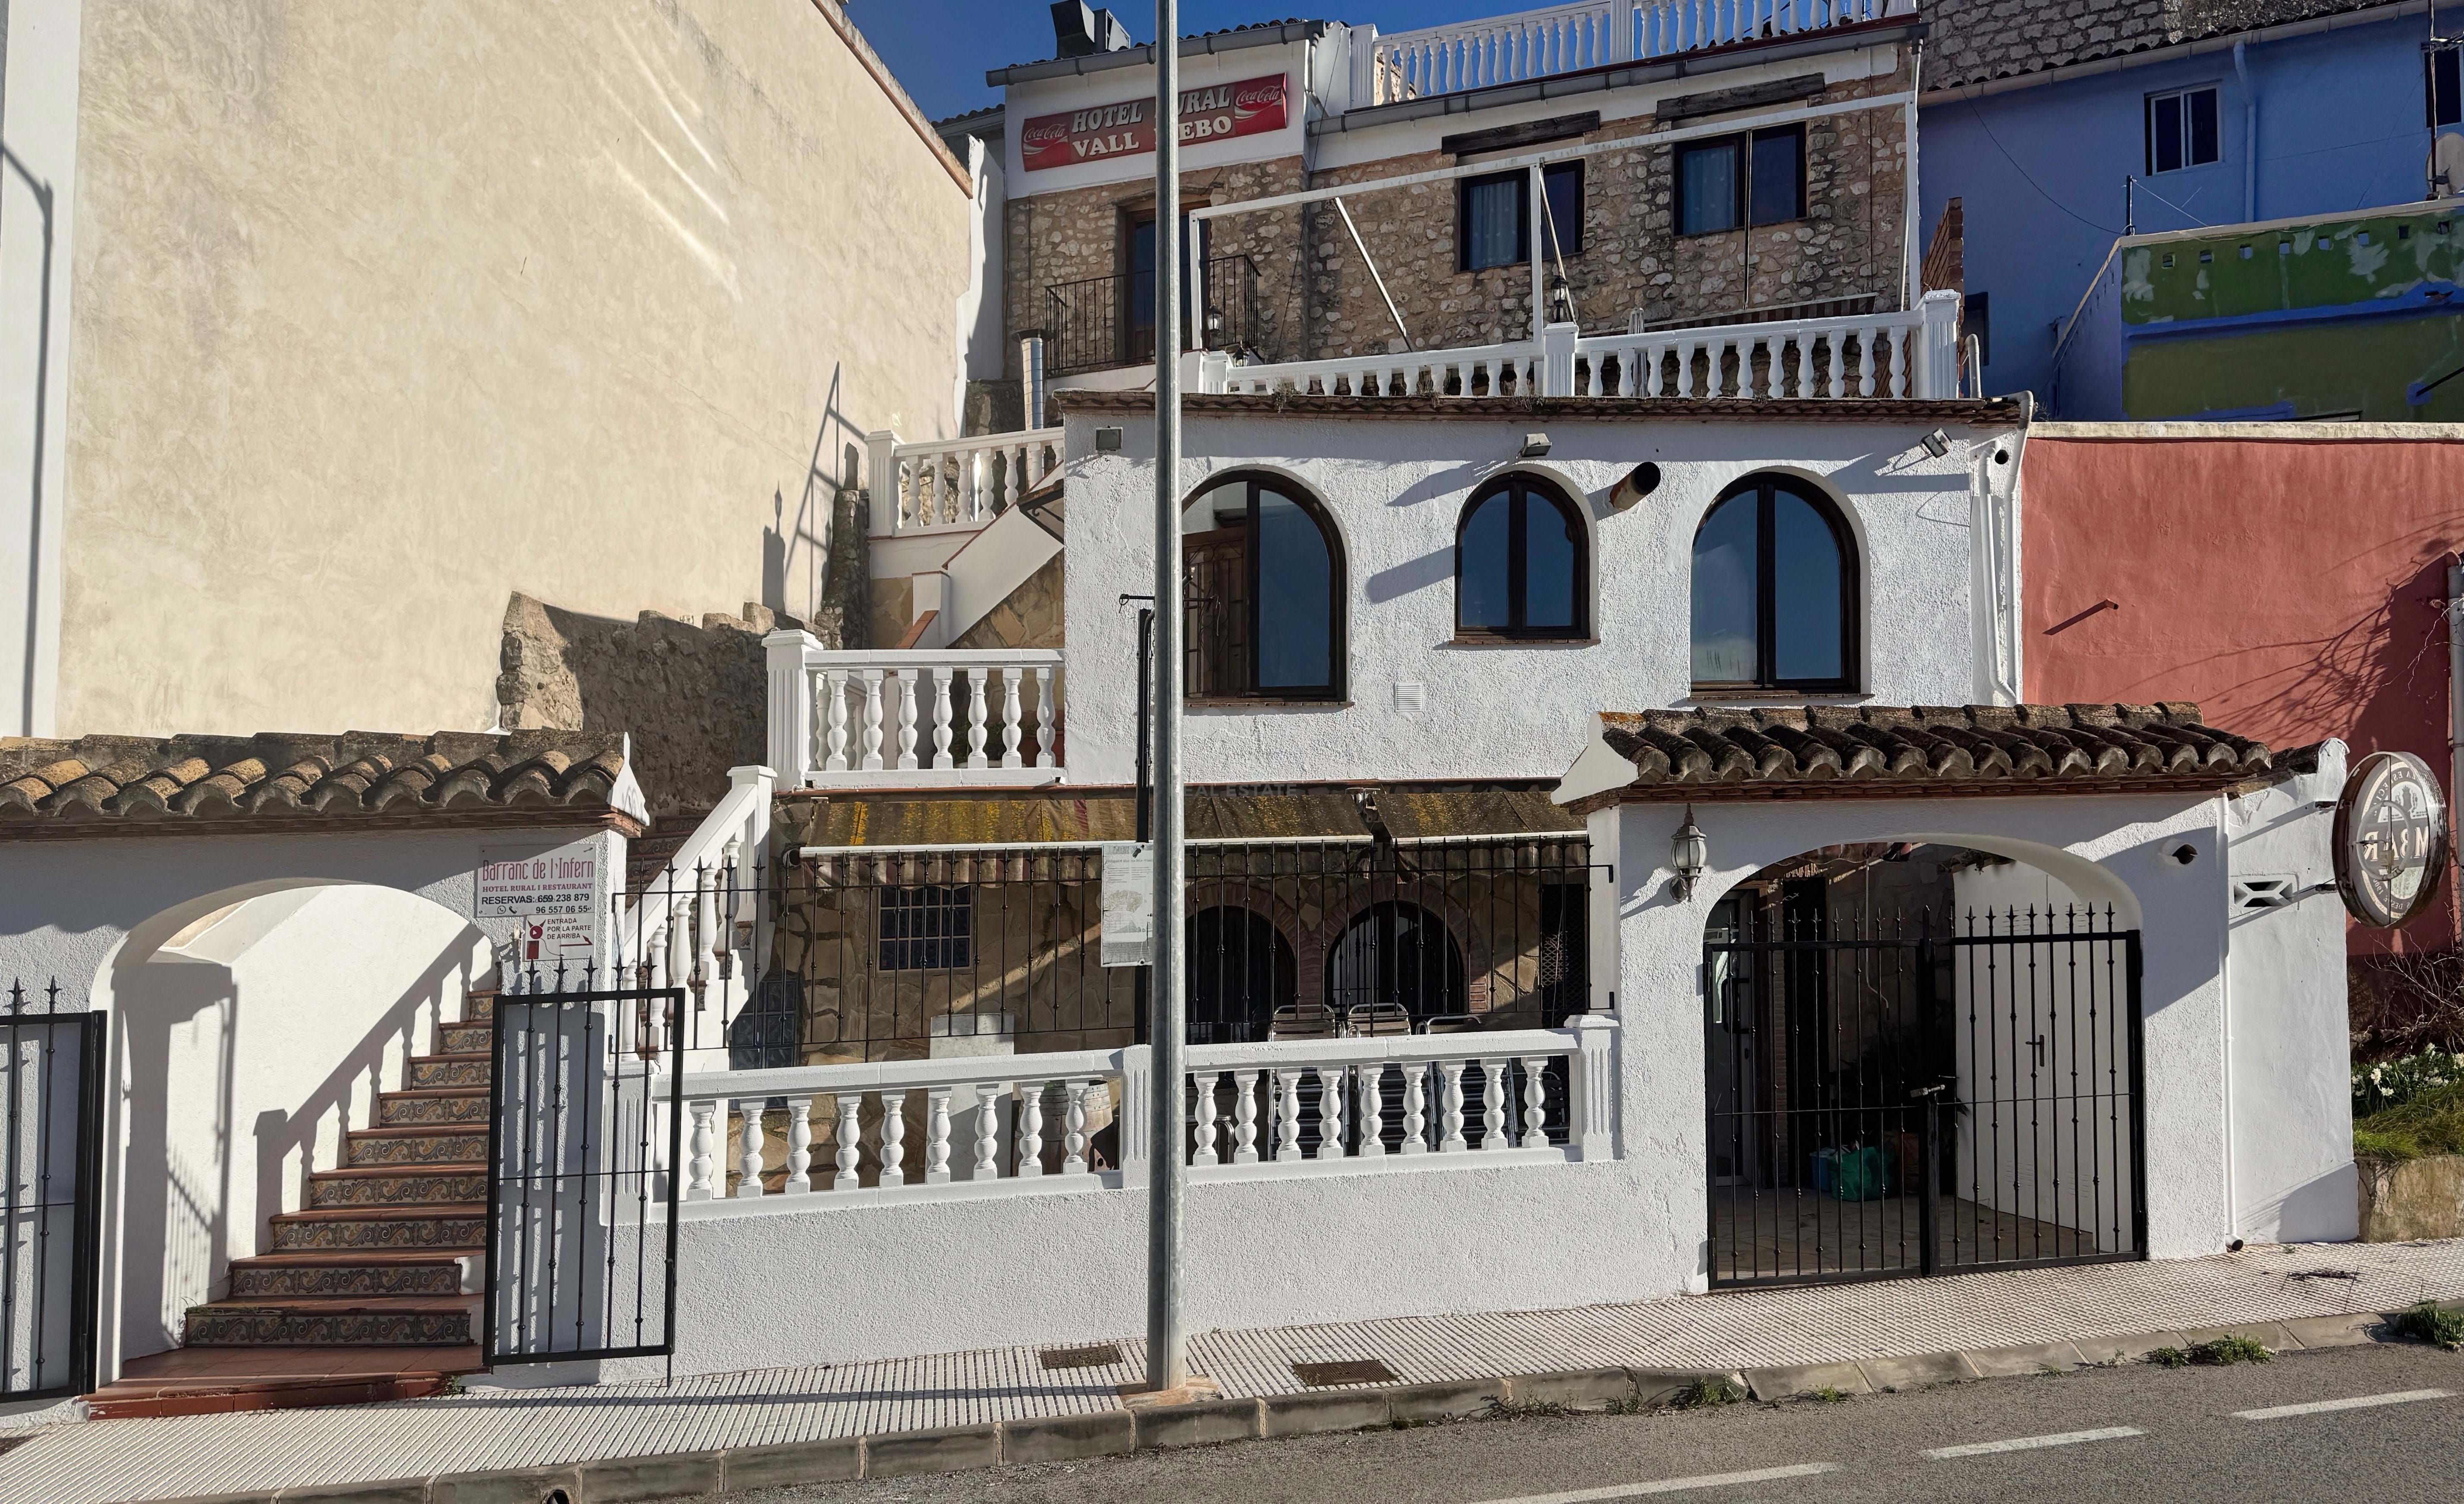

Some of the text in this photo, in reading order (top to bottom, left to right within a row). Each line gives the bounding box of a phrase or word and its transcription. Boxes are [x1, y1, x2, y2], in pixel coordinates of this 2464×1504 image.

[1072, 86, 1230, 133] HOTEL URAL
[1073, 132, 1139, 157] VALL
[483, 860, 528, 881] Barranc
[533, 859, 546, 879] de
[482, 893, 589, 905] RESERVAS: 659 238 879
